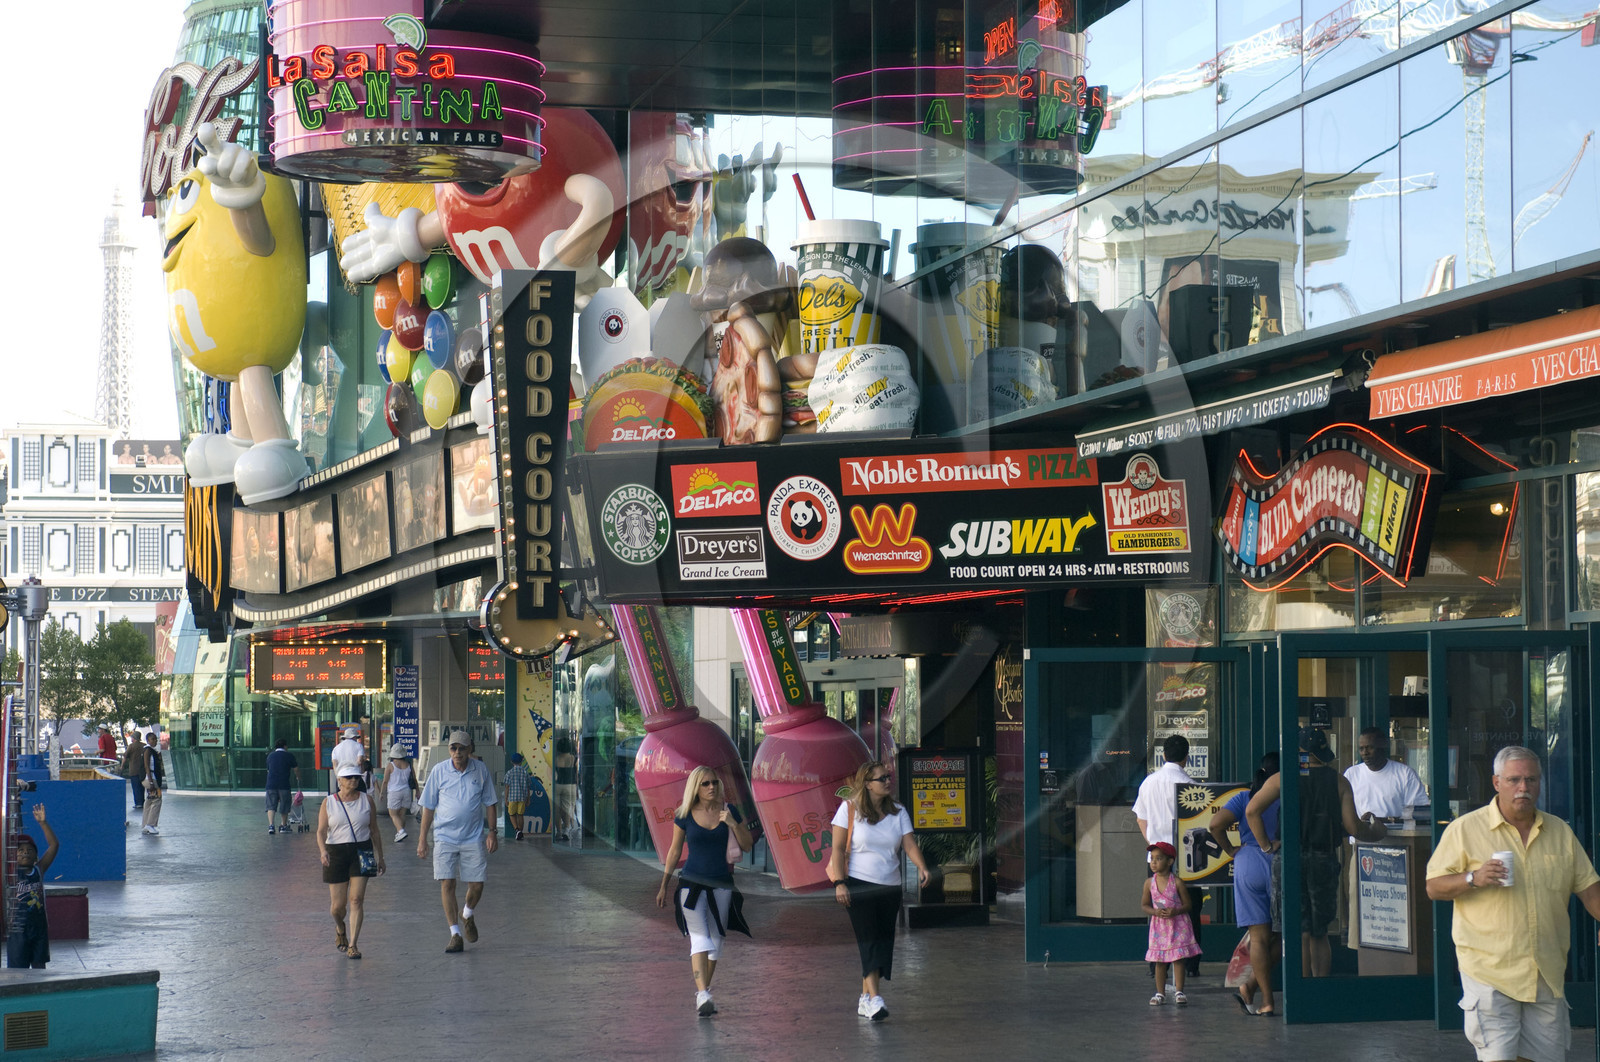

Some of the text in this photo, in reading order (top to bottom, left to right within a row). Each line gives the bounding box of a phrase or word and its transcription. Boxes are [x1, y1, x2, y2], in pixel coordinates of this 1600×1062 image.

[293, 71, 503, 130] CANTINA
[347, 131, 497, 144] MEXICAN FARE
[834, 255, 849, 265] THE
[850, 260, 871, 279] LEMON
[800, 282, 849, 311] Del's
[802, 328, 842, 337] FRESH
[802, 337, 855, 354] RUIT
[525, 279, 552, 417] FOOD
[837, 352, 873, 384] eat fresh.
[1531, 342, 1600, 385] YVES CHA
[869, 383, 908, 410] eat fresh.
[1377, 389, 1405, 414] YVES
[1407, 375, 1463, 409] CHANTRE
[1128, 432, 1153, 447] SONY
[1164, 426, 1181, 440] FUJI
[1185, 413, 1222, 433] TOURIST
[1222, 407, 1243, 427] INFO
[1252, 396, 1290, 420] TICKETS
[1297, 384, 1329, 409] TOURS
[847, 453, 1092, 492] Noble Roman's PIZZA
[604, 486, 667, 523] STARBUCKS
[771, 479, 837, 517] PANDA EXPRESS
[1370, 476, 1381, 515] FUJI
[525, 432, 552, 607] COURT
[1228, 494, 1241, 538] Canon
[1261, 465, 1363, 555] BLVD. Cameras
[1384, 489, 1400, 547] Nikon
[684, 536, 758, 560] Dreyer's
[939, 511, 1097, 559] SUBWAY
[1118, 537, 1181, 549] HAMBURGERS
[614, 539, 664, 561] COFFEE
[682, 566, 765, 578] Grand Ice Cream
[950, 561, 1190, 578] FOOD COURT OPEN 24 HRS ATM RESTROOMS
[72, 588, 107, 601] 1977
[1162, 595, 1199, 613] STARBUCKS
[1166, 623, 1194, 633] COFFEE
[777, 647, 801, 699] YARD
[396, 701, 418, 710] Canyon
[396, 717, 418, 725] Hoover
[913, 760, 964, 771] SHOWCASE
[1156, 755, 1207, 767] INNET
[1361, 884, 1407, 901] Las Vegas Shows
